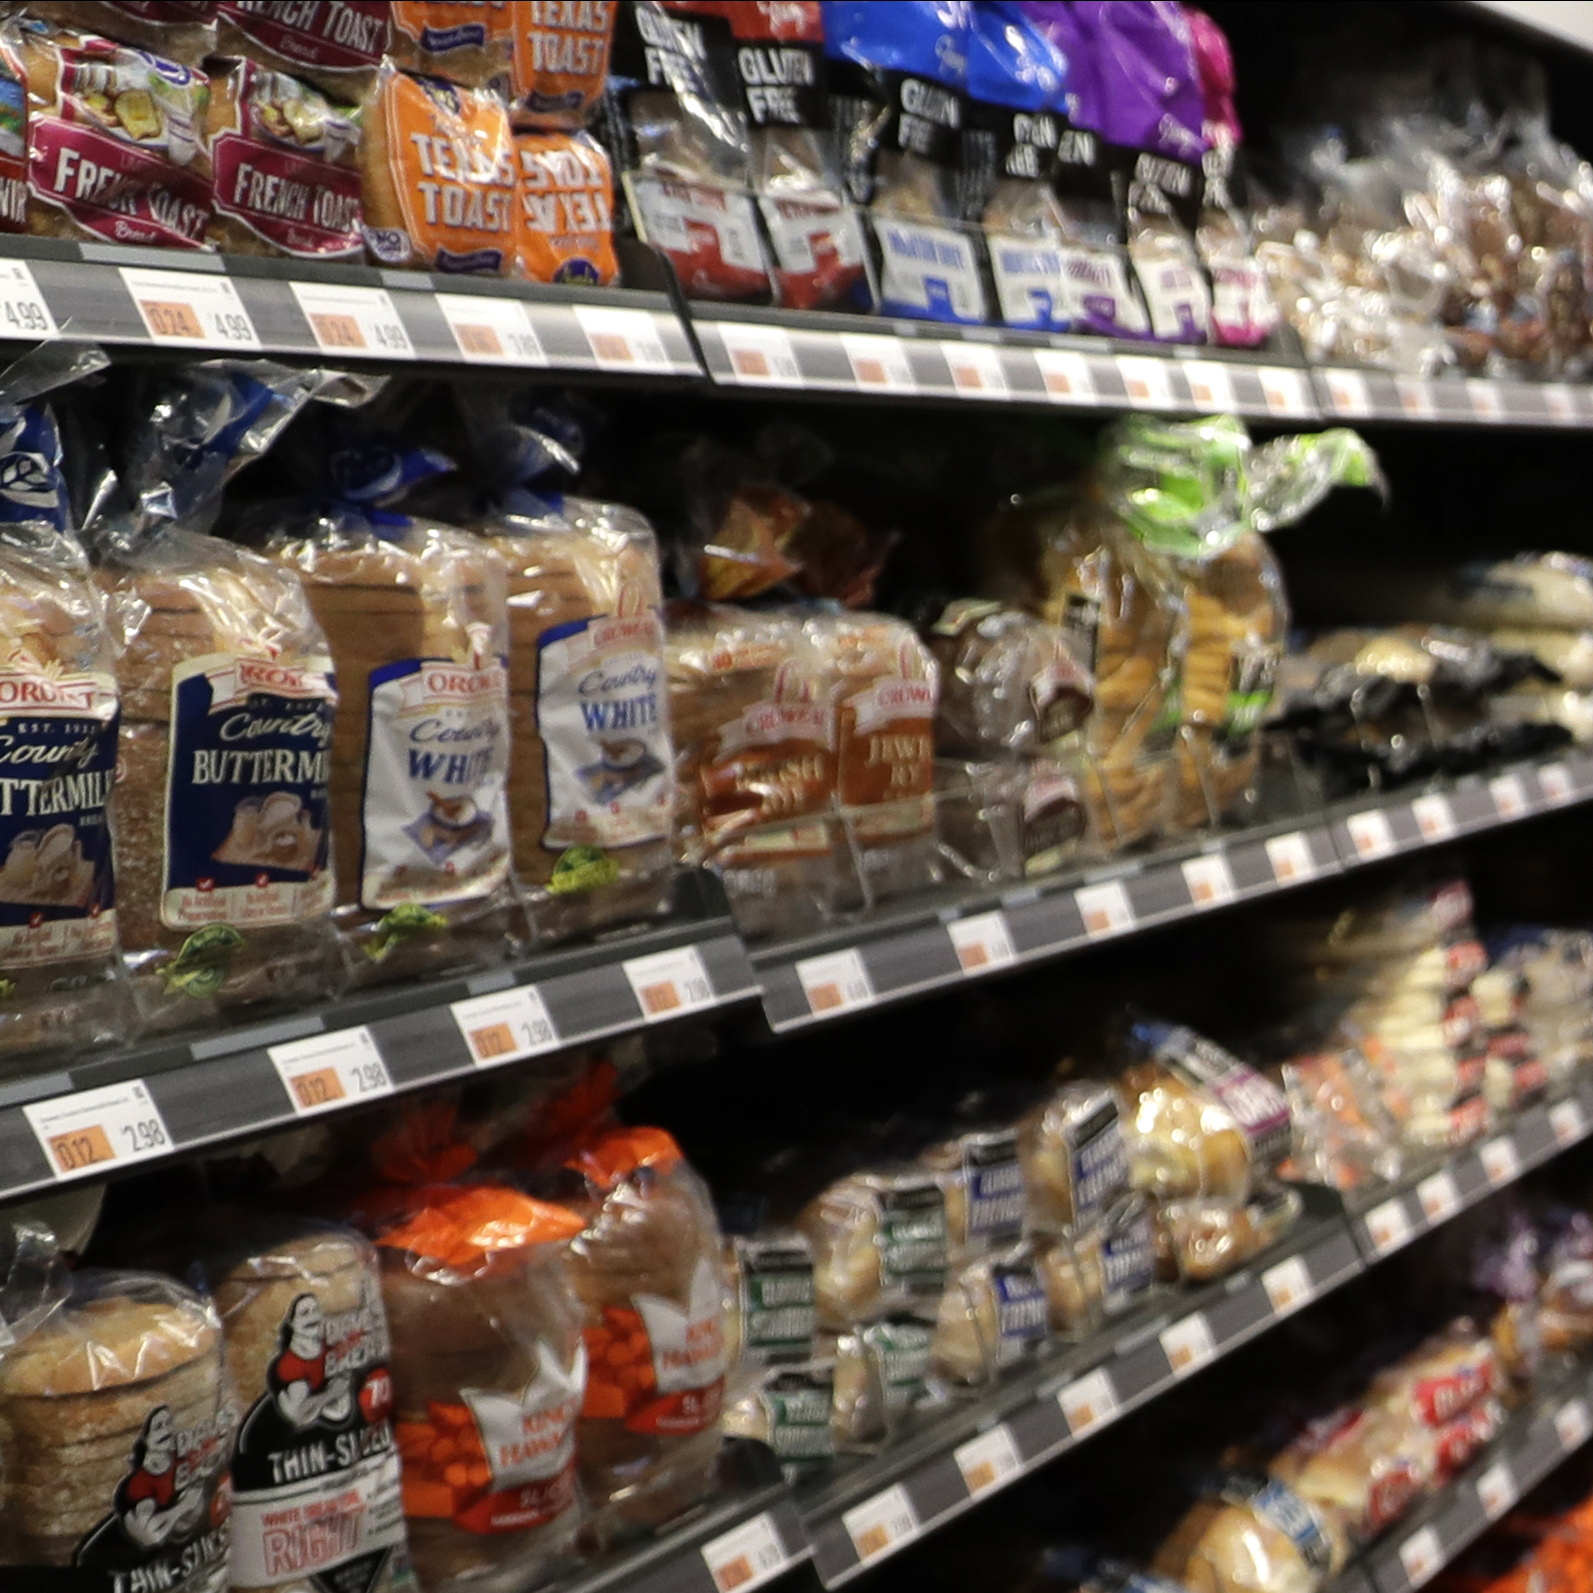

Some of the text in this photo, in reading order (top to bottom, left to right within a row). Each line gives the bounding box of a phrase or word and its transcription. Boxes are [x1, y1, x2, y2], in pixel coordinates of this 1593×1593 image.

[322, 3, 388, 56] TOAST
[528, 32, 605, 76] TOAST
[410, 132, 516, 188] TEXAS
[234, 163, 308, 221] FRENCH
[417, 182, 515, 234] TOAST
[376, 232, 400, 245] NO
[219, 711, 334, 750] Country
[125, 1119, 166, 1153] 2.98
